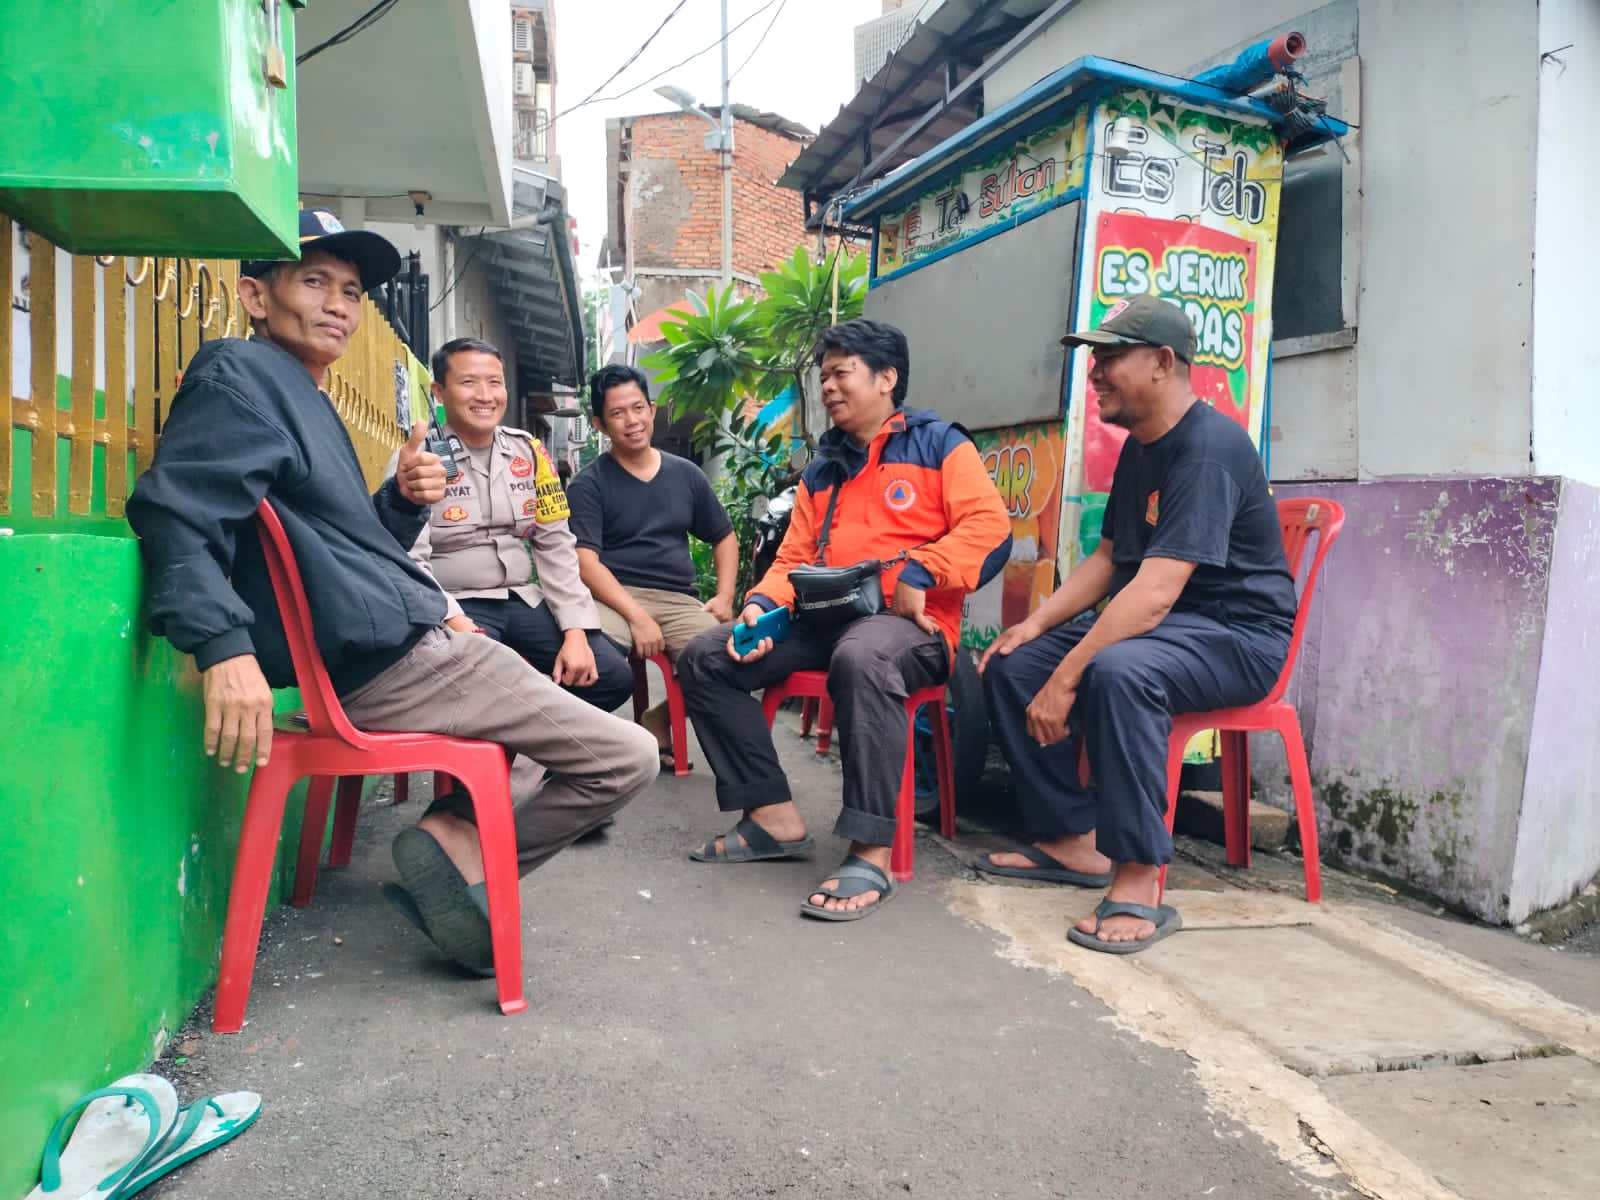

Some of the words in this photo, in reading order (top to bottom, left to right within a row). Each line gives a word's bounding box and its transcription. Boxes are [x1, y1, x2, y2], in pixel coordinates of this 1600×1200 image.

[978, 157, 1056, 219] Sultan
[1102, 122, 1176, 204] Es
[1192, 133, 1267, 224] Teh
[1101, 250, 1150, 295] ES
[1156, 250, 1246, 300] JERUK
[1168, 297, 1244, 362] RAS
[444, 486, 471, 497] AYAT
